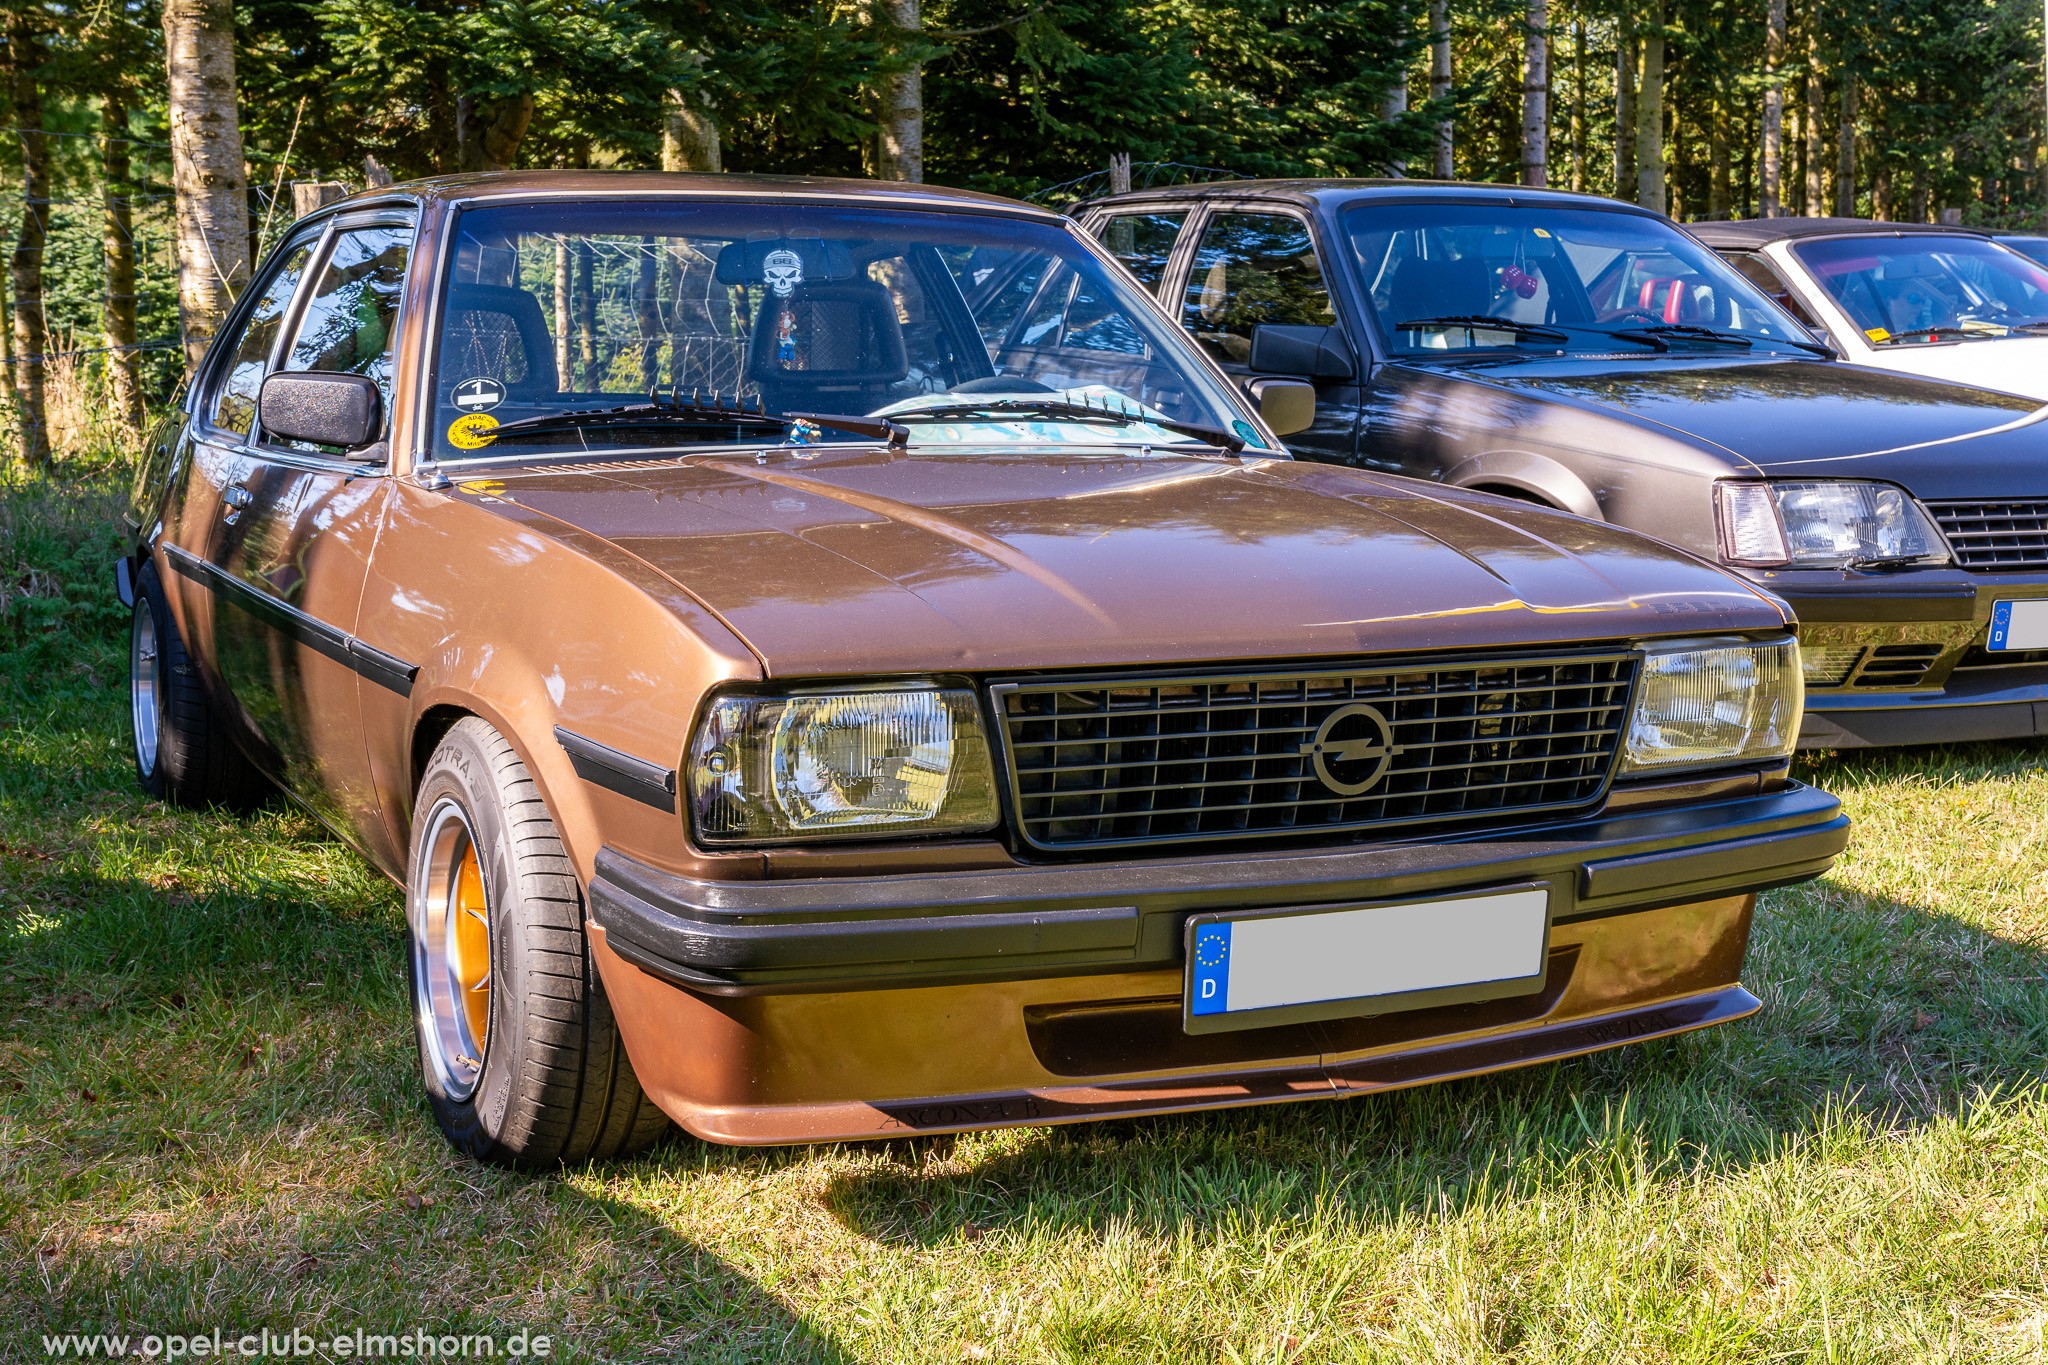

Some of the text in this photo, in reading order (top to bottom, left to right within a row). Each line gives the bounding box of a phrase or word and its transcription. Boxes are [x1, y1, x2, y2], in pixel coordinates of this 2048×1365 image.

[1994, 630, 2003, 642] D
[1201, 978, 1217, 999] D
[876, 1101, 1041, 1130] ASCONA B
